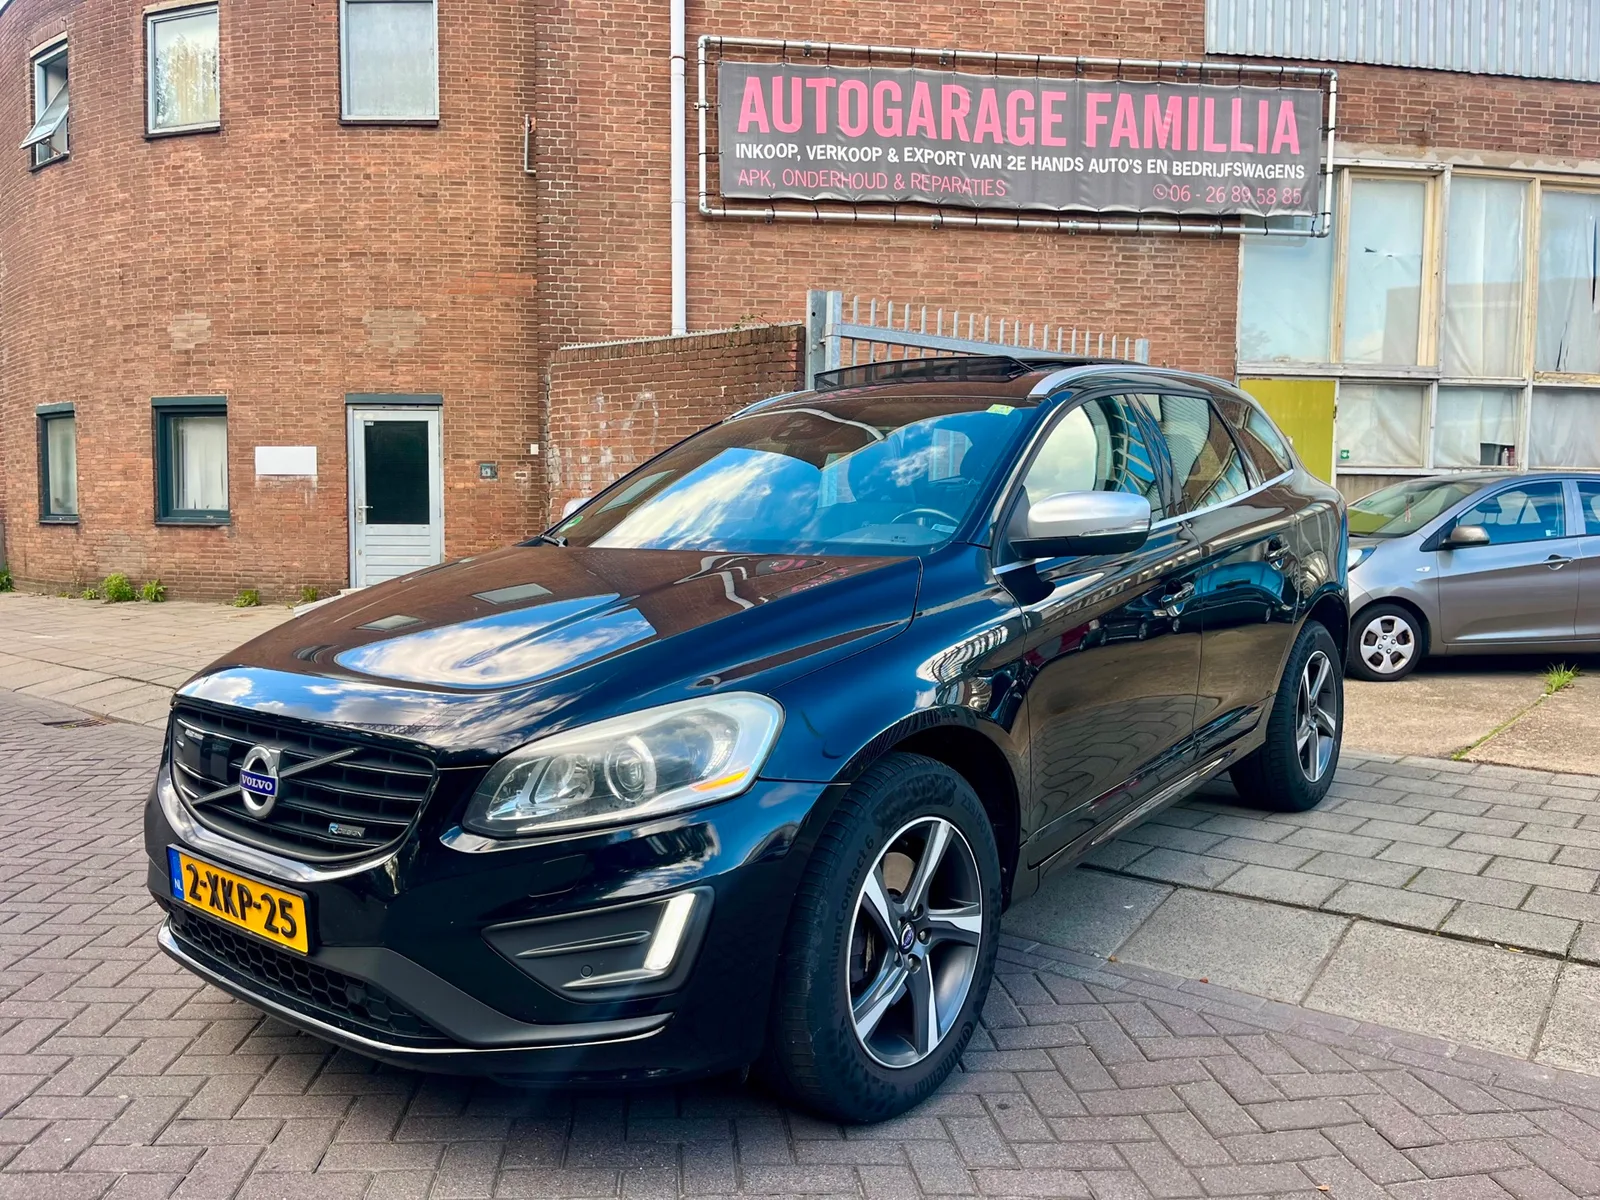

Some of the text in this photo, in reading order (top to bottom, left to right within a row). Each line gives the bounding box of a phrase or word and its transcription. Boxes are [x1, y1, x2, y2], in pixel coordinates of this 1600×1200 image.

[737, 76, 1300, 155] AUTOGARAGE FAMILLIA
[735, 143, 1305, 179] INKOOP, VERKOOP & EXPORT VAN 2E HANDS AUTO'S EN BEDRIJFSWAGENS
[738, 169, 1006, 196] APK, ONDERHOUD & REPARATIES
[1170, 185, 1191, 202] 06
[1206, 186, 1226, 203] 26
[1256, 187, 1277, 205] 58
[1282, 188, 1302, 205] 85
[241, 774, 273, 791] VOLVO
[174, 877, 183, 891] NL
[186, 863, 297, 939] 2-XKP-25
